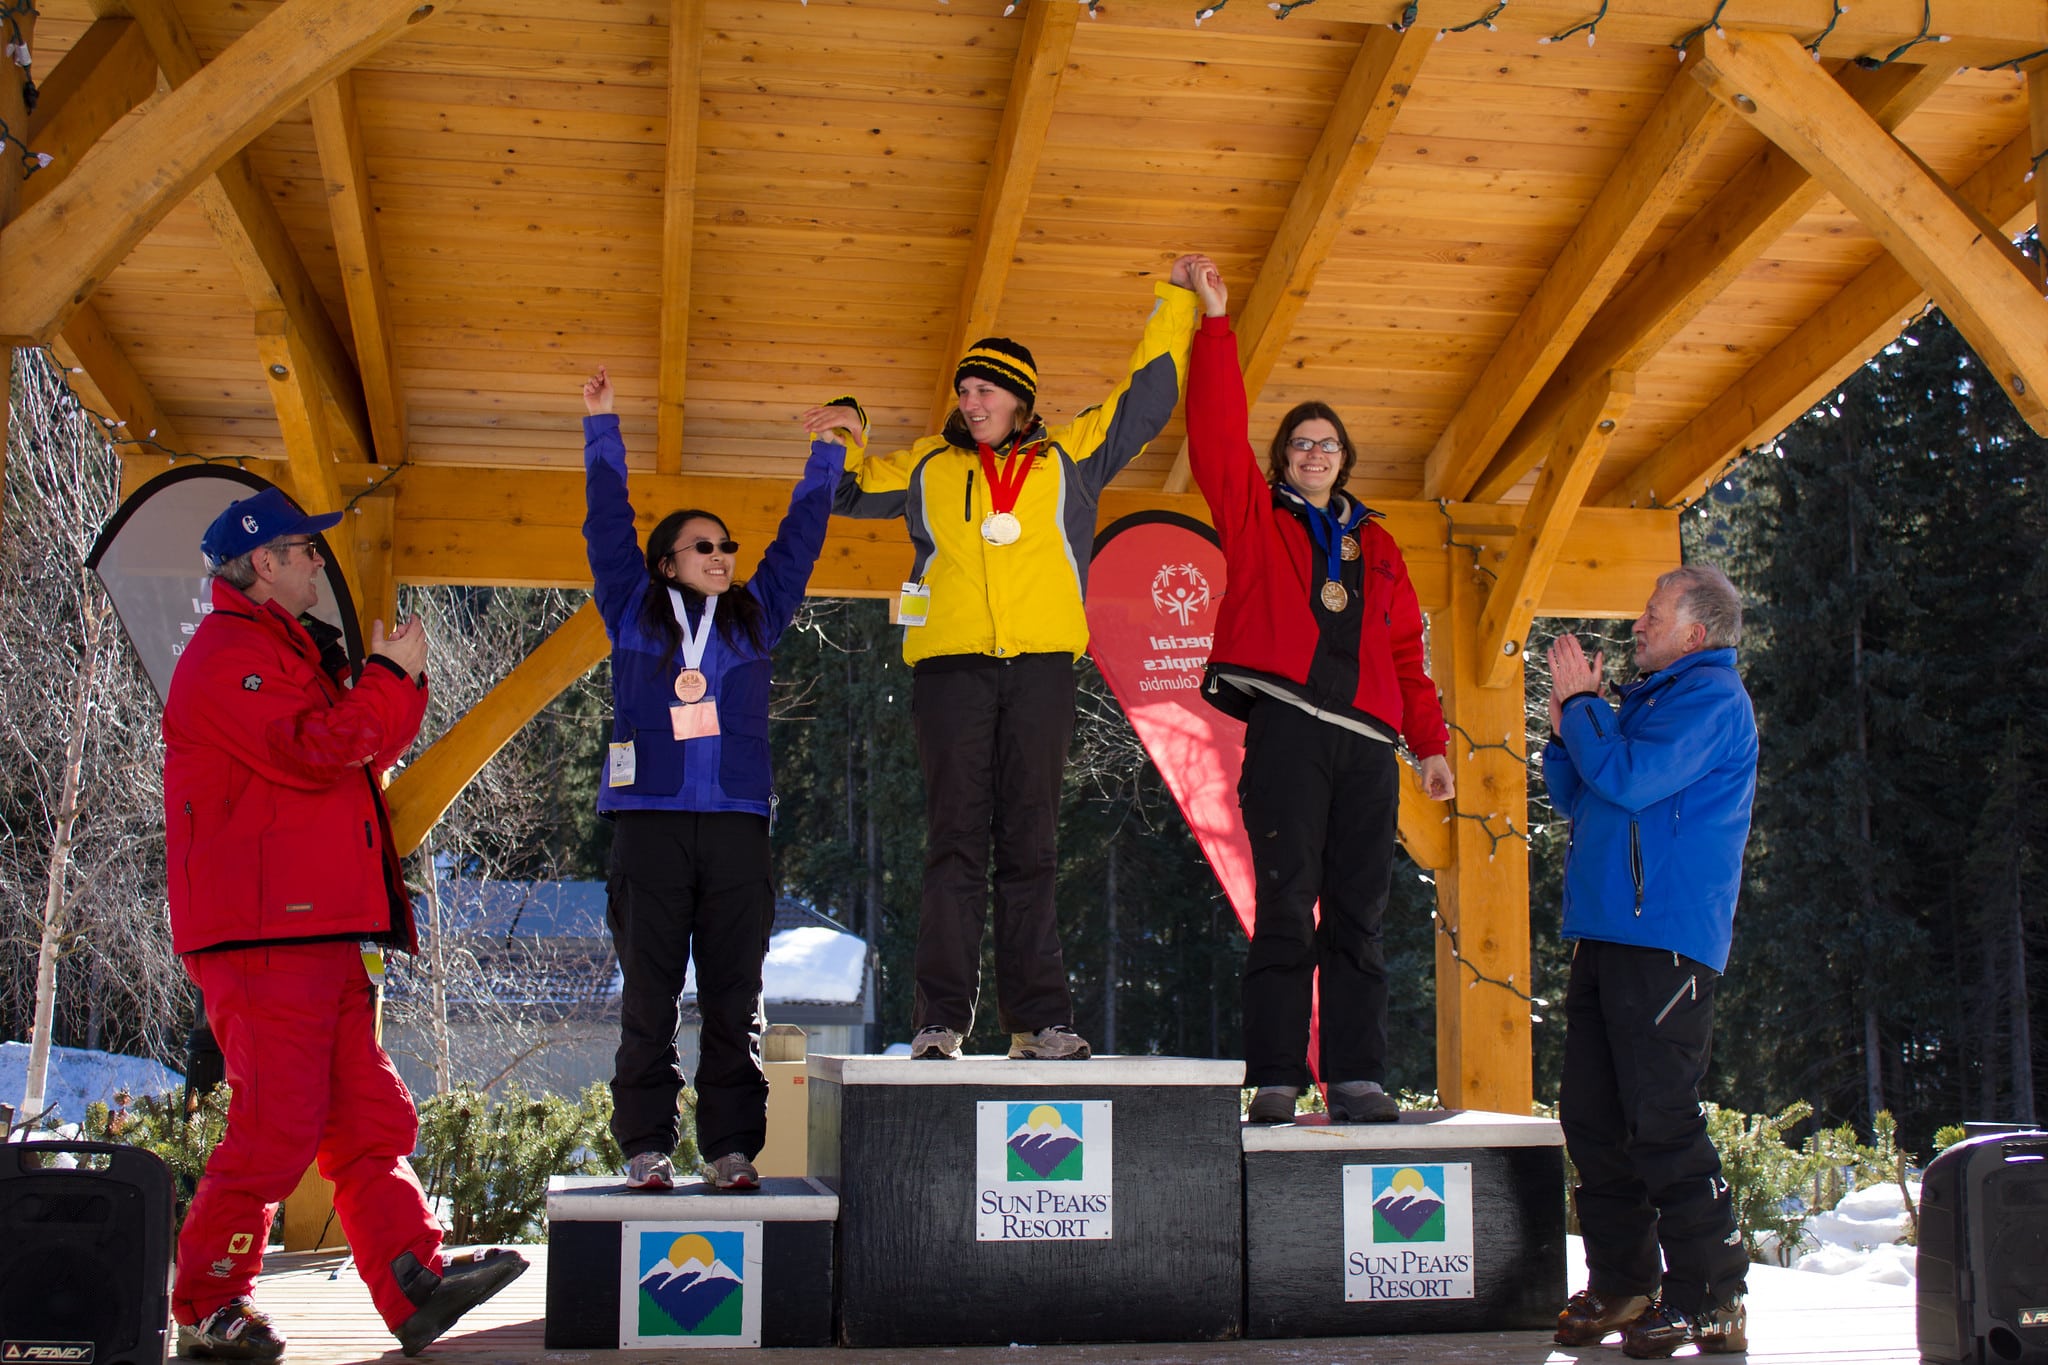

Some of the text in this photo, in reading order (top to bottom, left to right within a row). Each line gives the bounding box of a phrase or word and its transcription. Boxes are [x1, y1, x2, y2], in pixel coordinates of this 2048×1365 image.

[981, 1189, 1108, 1214] SUN PEAKS
[1001, 1214, 1090, 1238] RESORT
[1349, 1250, 1469, 1275] SUN PEAKS
[1368, 1275, 1453, 1299] RESORT
[23, 1346, 91, 1359] PEAVEY
